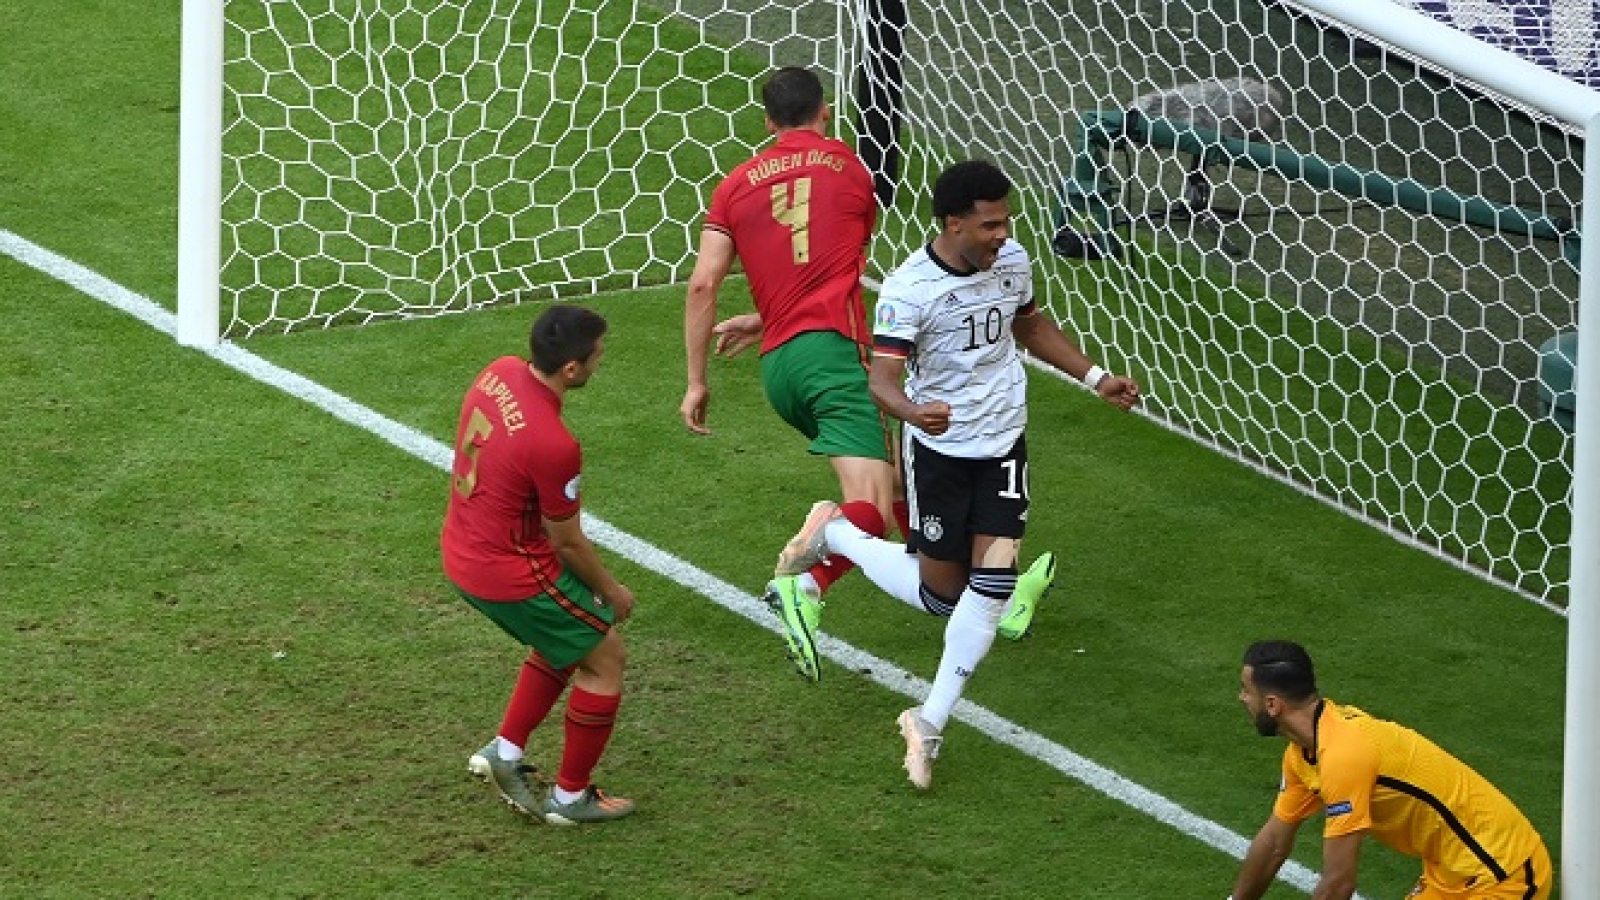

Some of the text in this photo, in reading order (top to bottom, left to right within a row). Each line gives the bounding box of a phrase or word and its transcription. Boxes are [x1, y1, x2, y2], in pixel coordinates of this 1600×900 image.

[746, 149, 844, 186] RÚBEN DIAS
[770, 177, 811, 265] 4
[962, 308, 1001, 351] 10
[455, 407, 494, 498] 5
